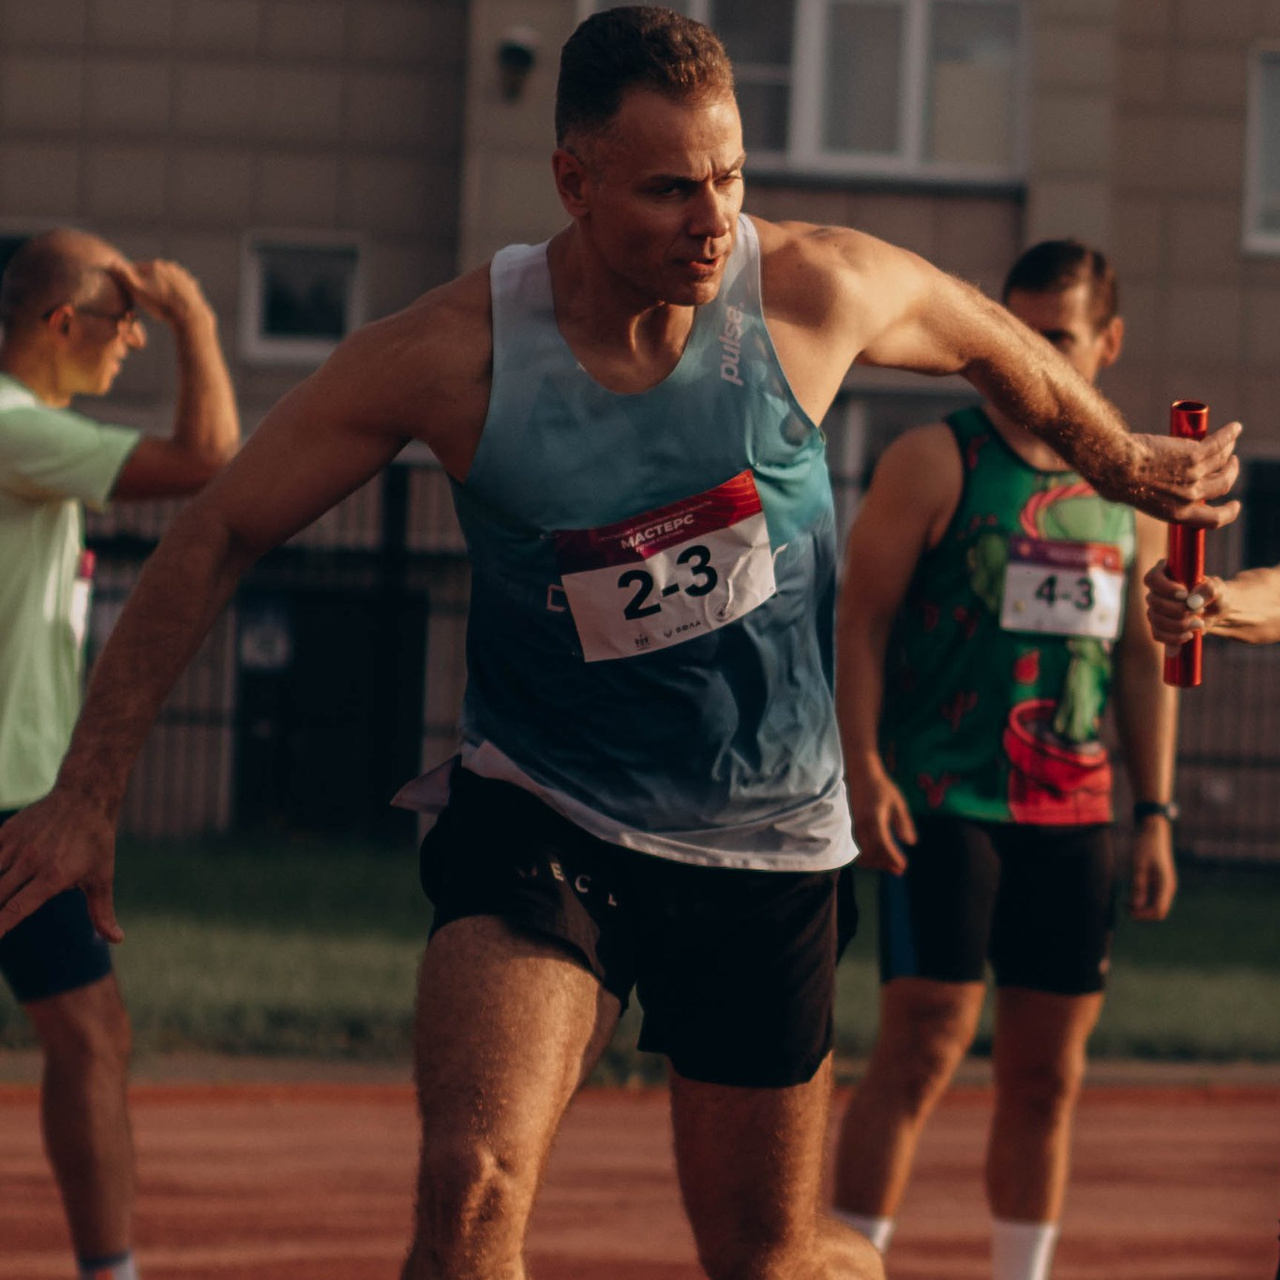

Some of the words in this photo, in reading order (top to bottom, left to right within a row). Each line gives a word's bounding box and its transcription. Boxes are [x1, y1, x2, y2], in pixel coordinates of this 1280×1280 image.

[620, 514, 695, 549] МАСТЕРС
[617, 545, 718, 620] 2-3
[1035, 575, 1095, 611] 4-3
